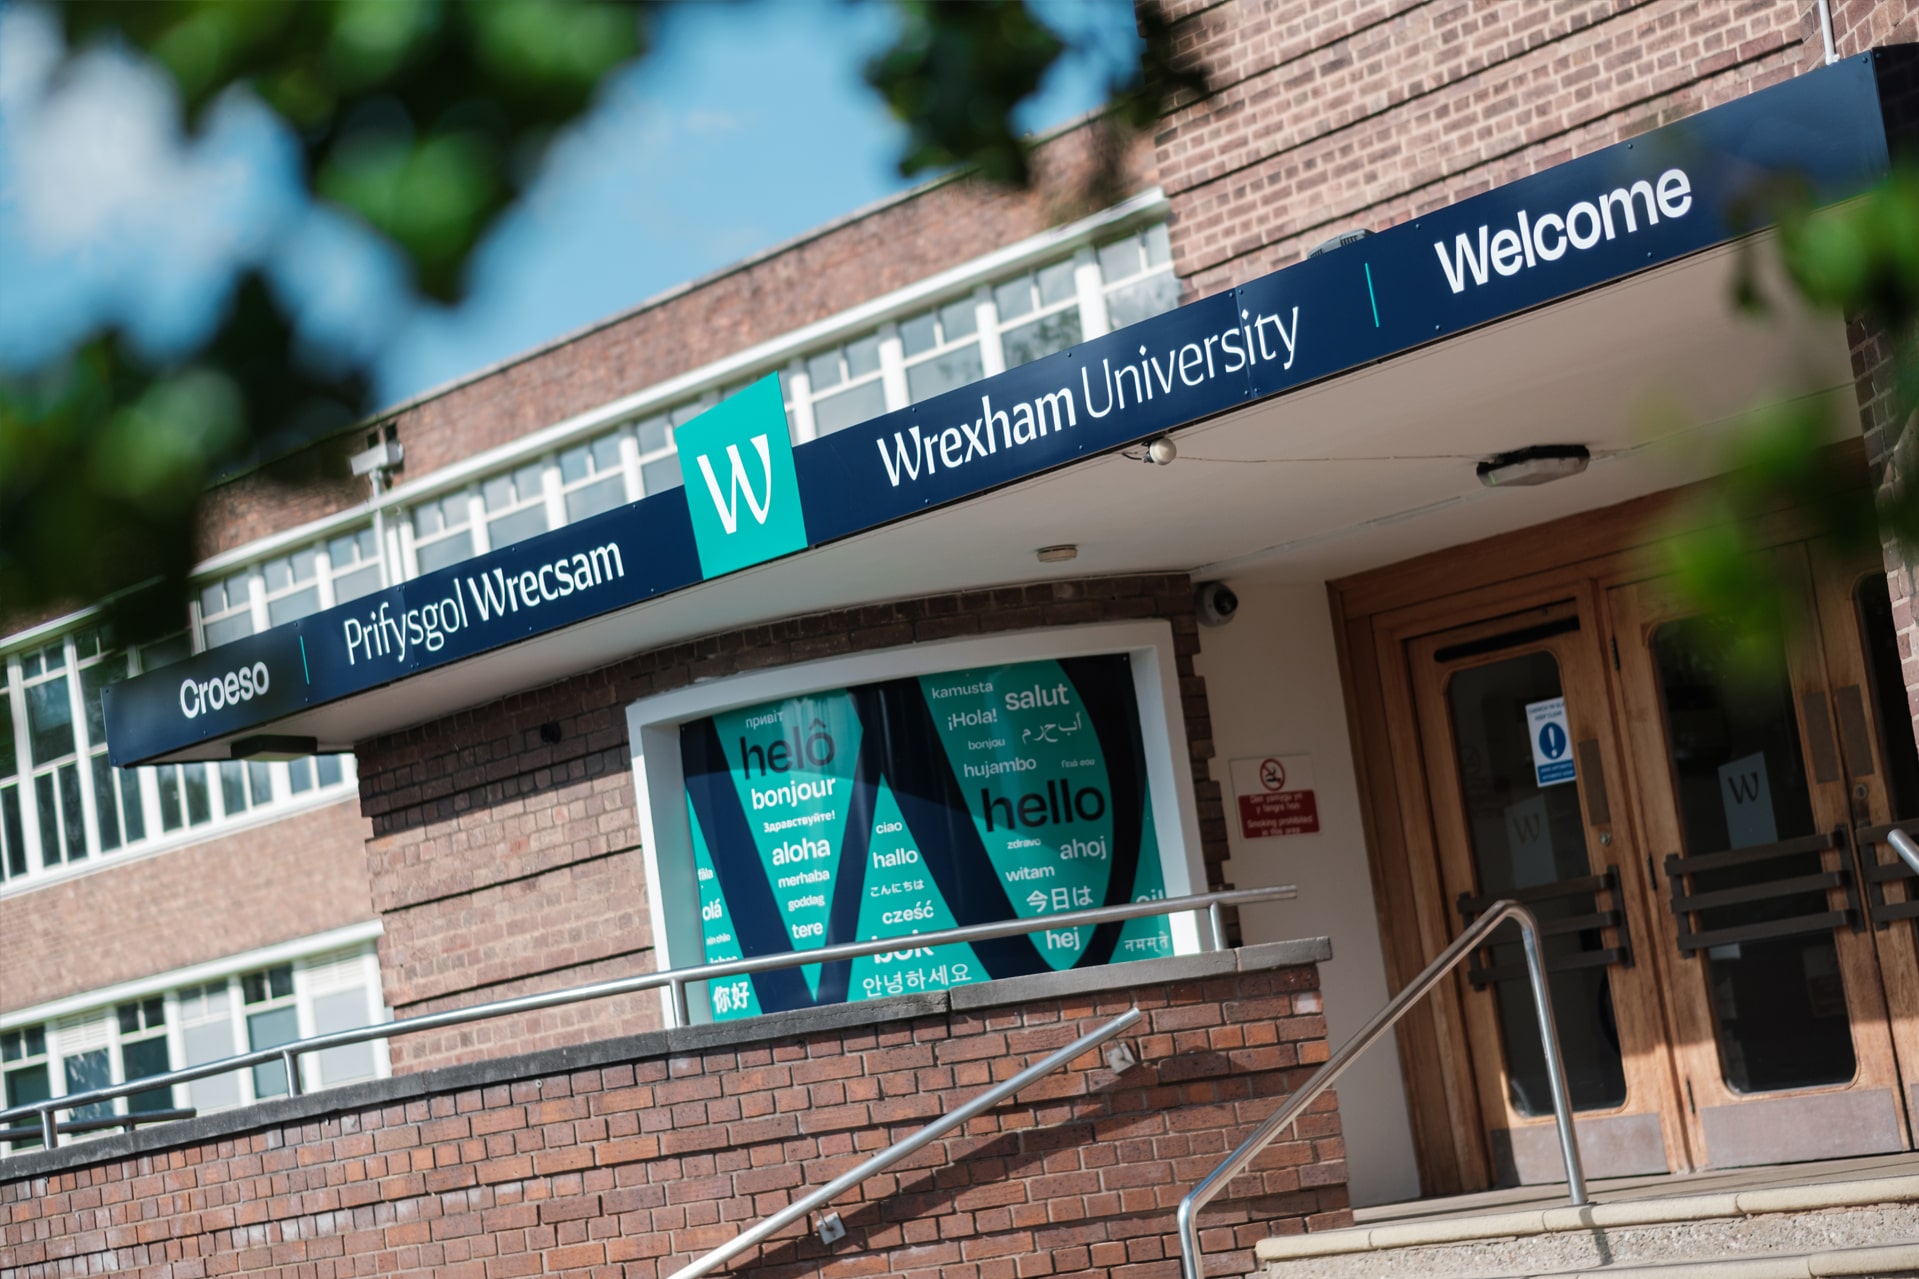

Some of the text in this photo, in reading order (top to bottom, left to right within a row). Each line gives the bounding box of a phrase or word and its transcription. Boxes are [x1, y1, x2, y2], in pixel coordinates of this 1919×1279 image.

[1434, 168, 1692, 294] Welcome
[877, 306, 1299, 487] Wrexham University
[696, 434, 772, 535] W
[344, 541, 625, 667] Prifysgol Wrecsam
[179, 661, 269, 719] Croeso
[931, 681, 994, 699] kamusta
[1004, 683, 1070, 711] salut
[947, 707, 998, 731] ¡Hola!
[739, 717, 836, 780] helô
[968, 738, 1005, 751] bonjou
[963, 757, 1037, 779] hujambo
[751, 777, 836, 810] bonjour
[980, 778, 1106, 833] hello
[875, 821, 903, 834] ciao
[772, 837, 831, 866] aloha
[1007, 837, 1041, 850] zdravo
[1059, 836, 1107, 860] ahoj
[872, 848, 919, 869] hallo
[778, 869, 830, 889] merhaba
[1005, 865, 1055, 882] witam
[870, 879, 925, 898] こんにちは
[1026, 885, 1093, 913] 今日は
[702, 898, 722, 921] olá
[787, 894, 825, 912] goddag
[882, 900, 934, 925] cześć
[792, 922, 823, 939] tere
[1045, 927, 1080, 951] hej
[862, 963, 972, 998] 안녕하세요
[713, 981, 750, 1014] 你好
